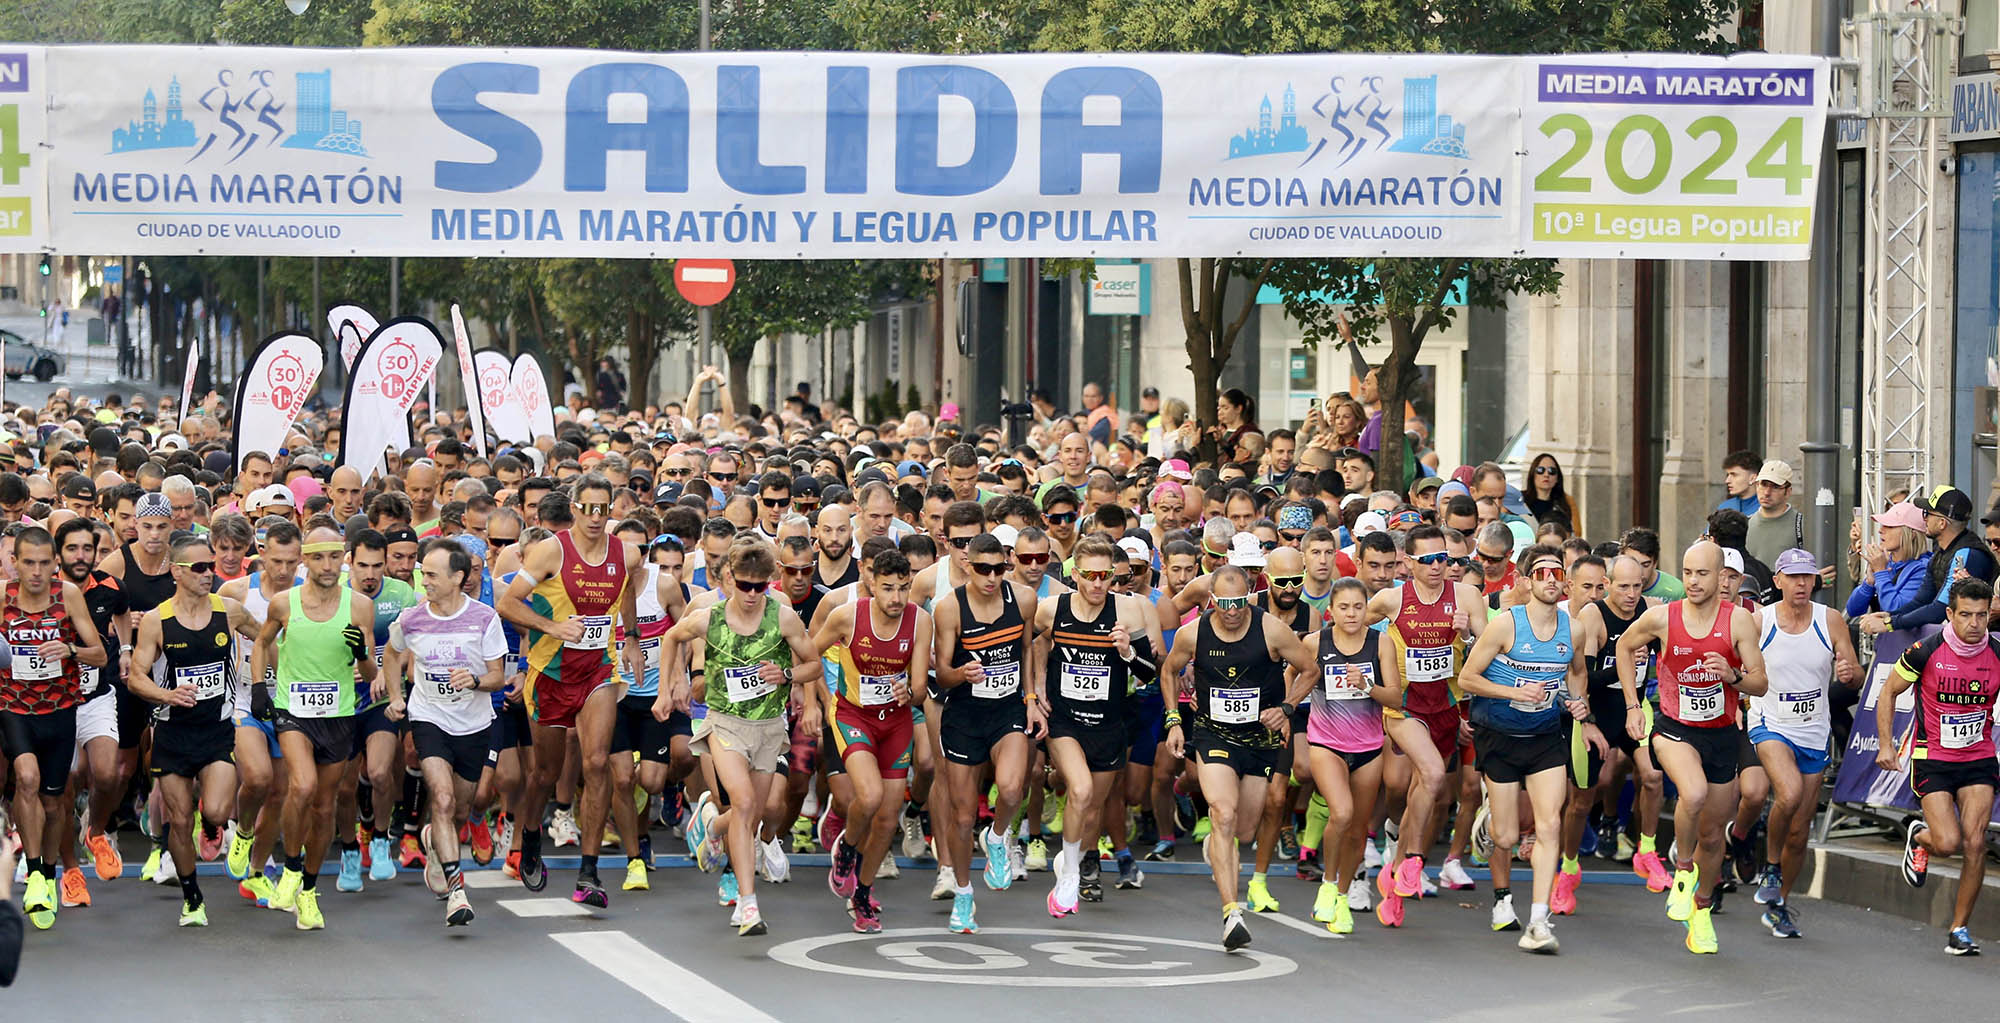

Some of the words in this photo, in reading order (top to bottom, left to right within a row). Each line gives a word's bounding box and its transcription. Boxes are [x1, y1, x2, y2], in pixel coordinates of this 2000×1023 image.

[1547, 74, 1647, 95] MEDIA
[1656, 73, 1806, 97] MARATÓN
[431, 62, 1164, 196] SALIDA
[1534, 113, 1813, 196] 2024
[74, 172, 198, 203] MEDIA
[210, 167, 402, 204] MARATÓN
[1188, 177, 1309, 206] MEDIA
[1320, 169, 1502, 207] MARATÓN
[432, 208, 563, 241] MEDIA
[580, 203, 776, 242] MARATÓN
[792, 211, 818, 242] Y
[833, 211, 958, 242] LEGUA
[973, 210, 1158, 241] POPULAR
[1542, 211, 1584, 234] 10ª
[1595, 213, 1681, 240] Legua
[1692, 214, 1804, 241] Popular
[137, 223, 202, 237] CIUDAD
[208, 224, 231, 237] DE
[234, 223, 341, 239] VALLADOLID
[1249, 226, 1311, 240] CIUDAD
[1315, 226, 1335, 239] DE
[1338, 225, 1442, 240] VALLADOLID
[1103, 280, 1136, 291] caser
[399, 355, 436, 408] MAPFRE
[8, 628, 61, 641] KENYA
[581, 626, 602, 639] 30
[988, 644, 1014, 657] VICKY
[1078, 651, 1107, 662] VICKY
[29, 657, 47, 669] 52
[1415, 656, 1449, 672] 1583
[80, 671, 90, 684] 3
[1228, 666, 1237, 678] S
[985, 673, 1015, 689] 1545
[1073, 675, 1100, 690] 526
[300, 693, 334, 706] 1438
[1224, 699, 1250, 713] 585
[1690, 697, 1716, 711] 596
[1792, 699, 1815, 714] 405
[1952, 722, 1982, 738] 1412
